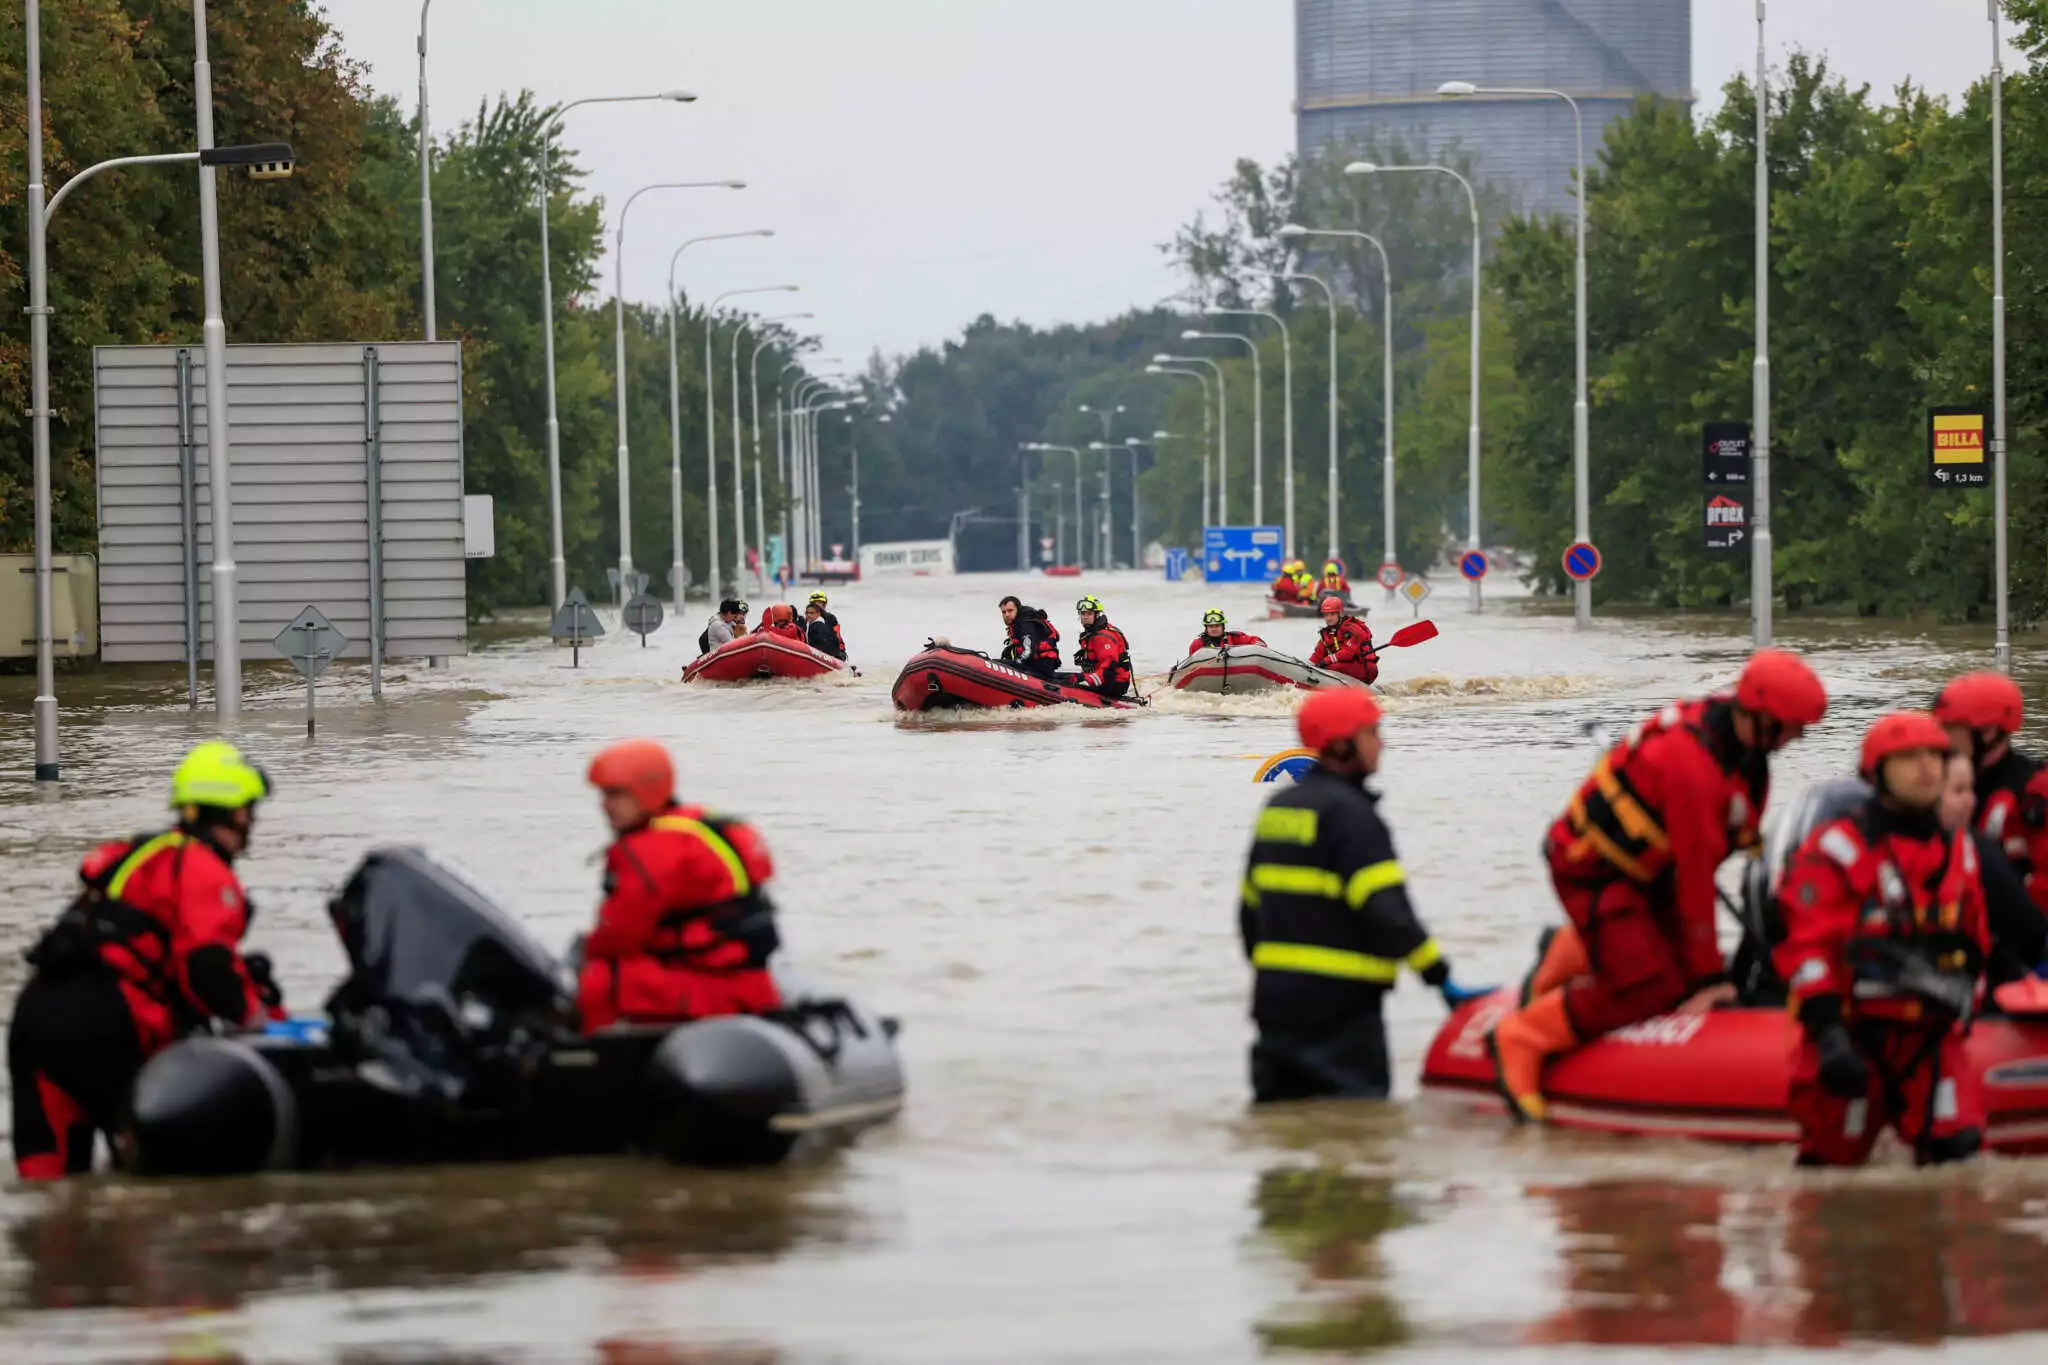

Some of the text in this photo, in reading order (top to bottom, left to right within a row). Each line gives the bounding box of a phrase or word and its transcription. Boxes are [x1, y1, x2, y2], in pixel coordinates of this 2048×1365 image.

[1937, 432, 1980, 447] BILLA
[1955, 473, 1983, 483] 1,3 km
